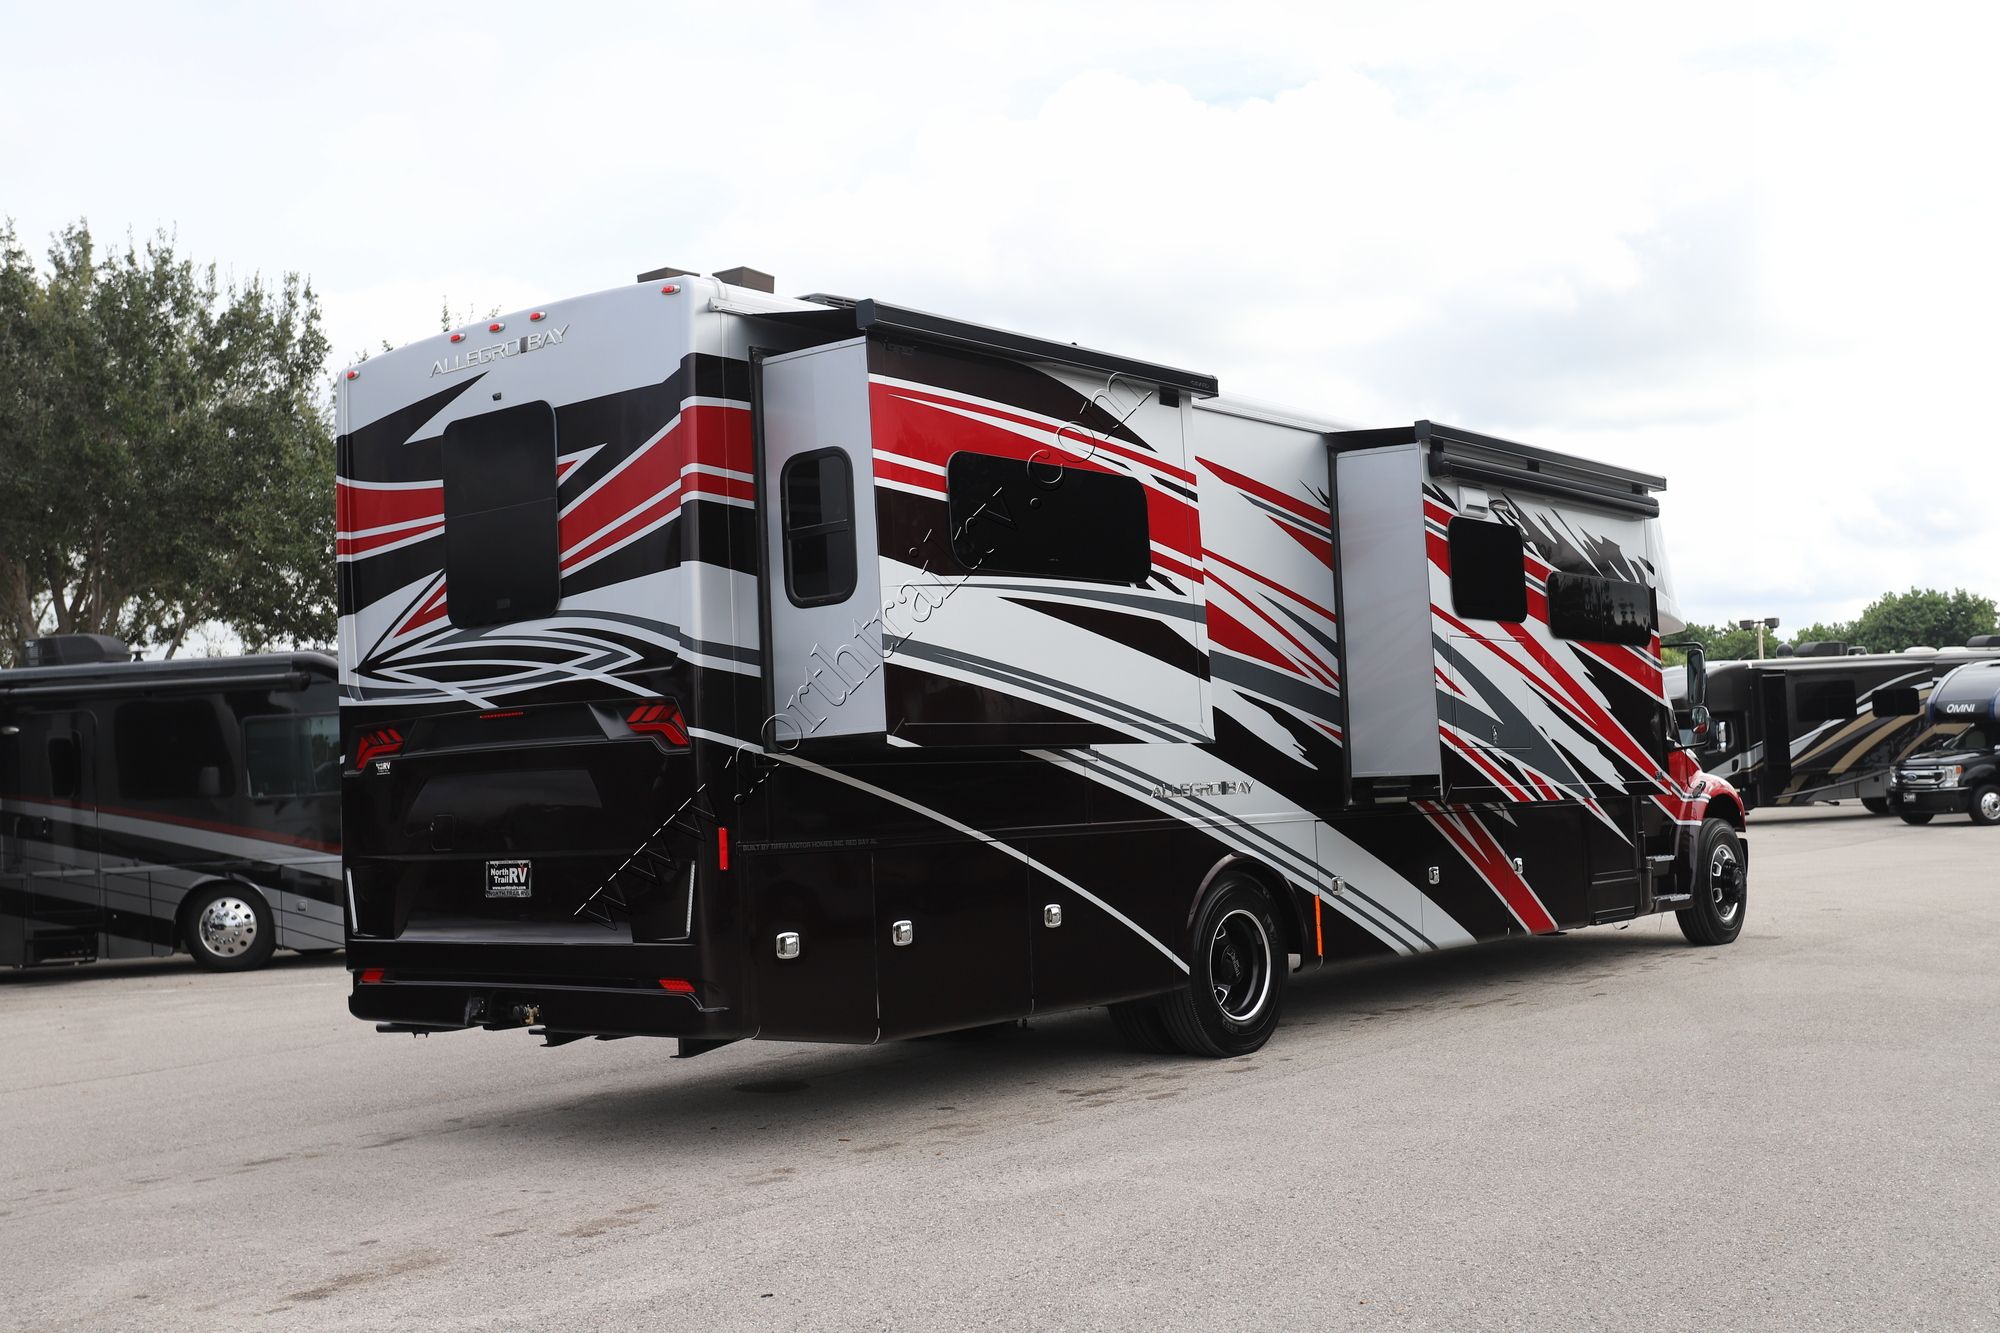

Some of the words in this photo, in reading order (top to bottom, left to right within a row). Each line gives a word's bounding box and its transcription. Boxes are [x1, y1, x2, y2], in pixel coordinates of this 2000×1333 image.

[429, 338, 521, 379] ALLEGRO
[527, 323, 570, 352] BAY
[1946, 703, 1976, 714] OMNI
[1150, 781, 1222, 799] ALLEGRO
[1226, 779, 1255, 796] BAY
[490, 868, 508, 876] North
[509, 867, 527, 884] RV
[493, 876, 508, 884] Trail
